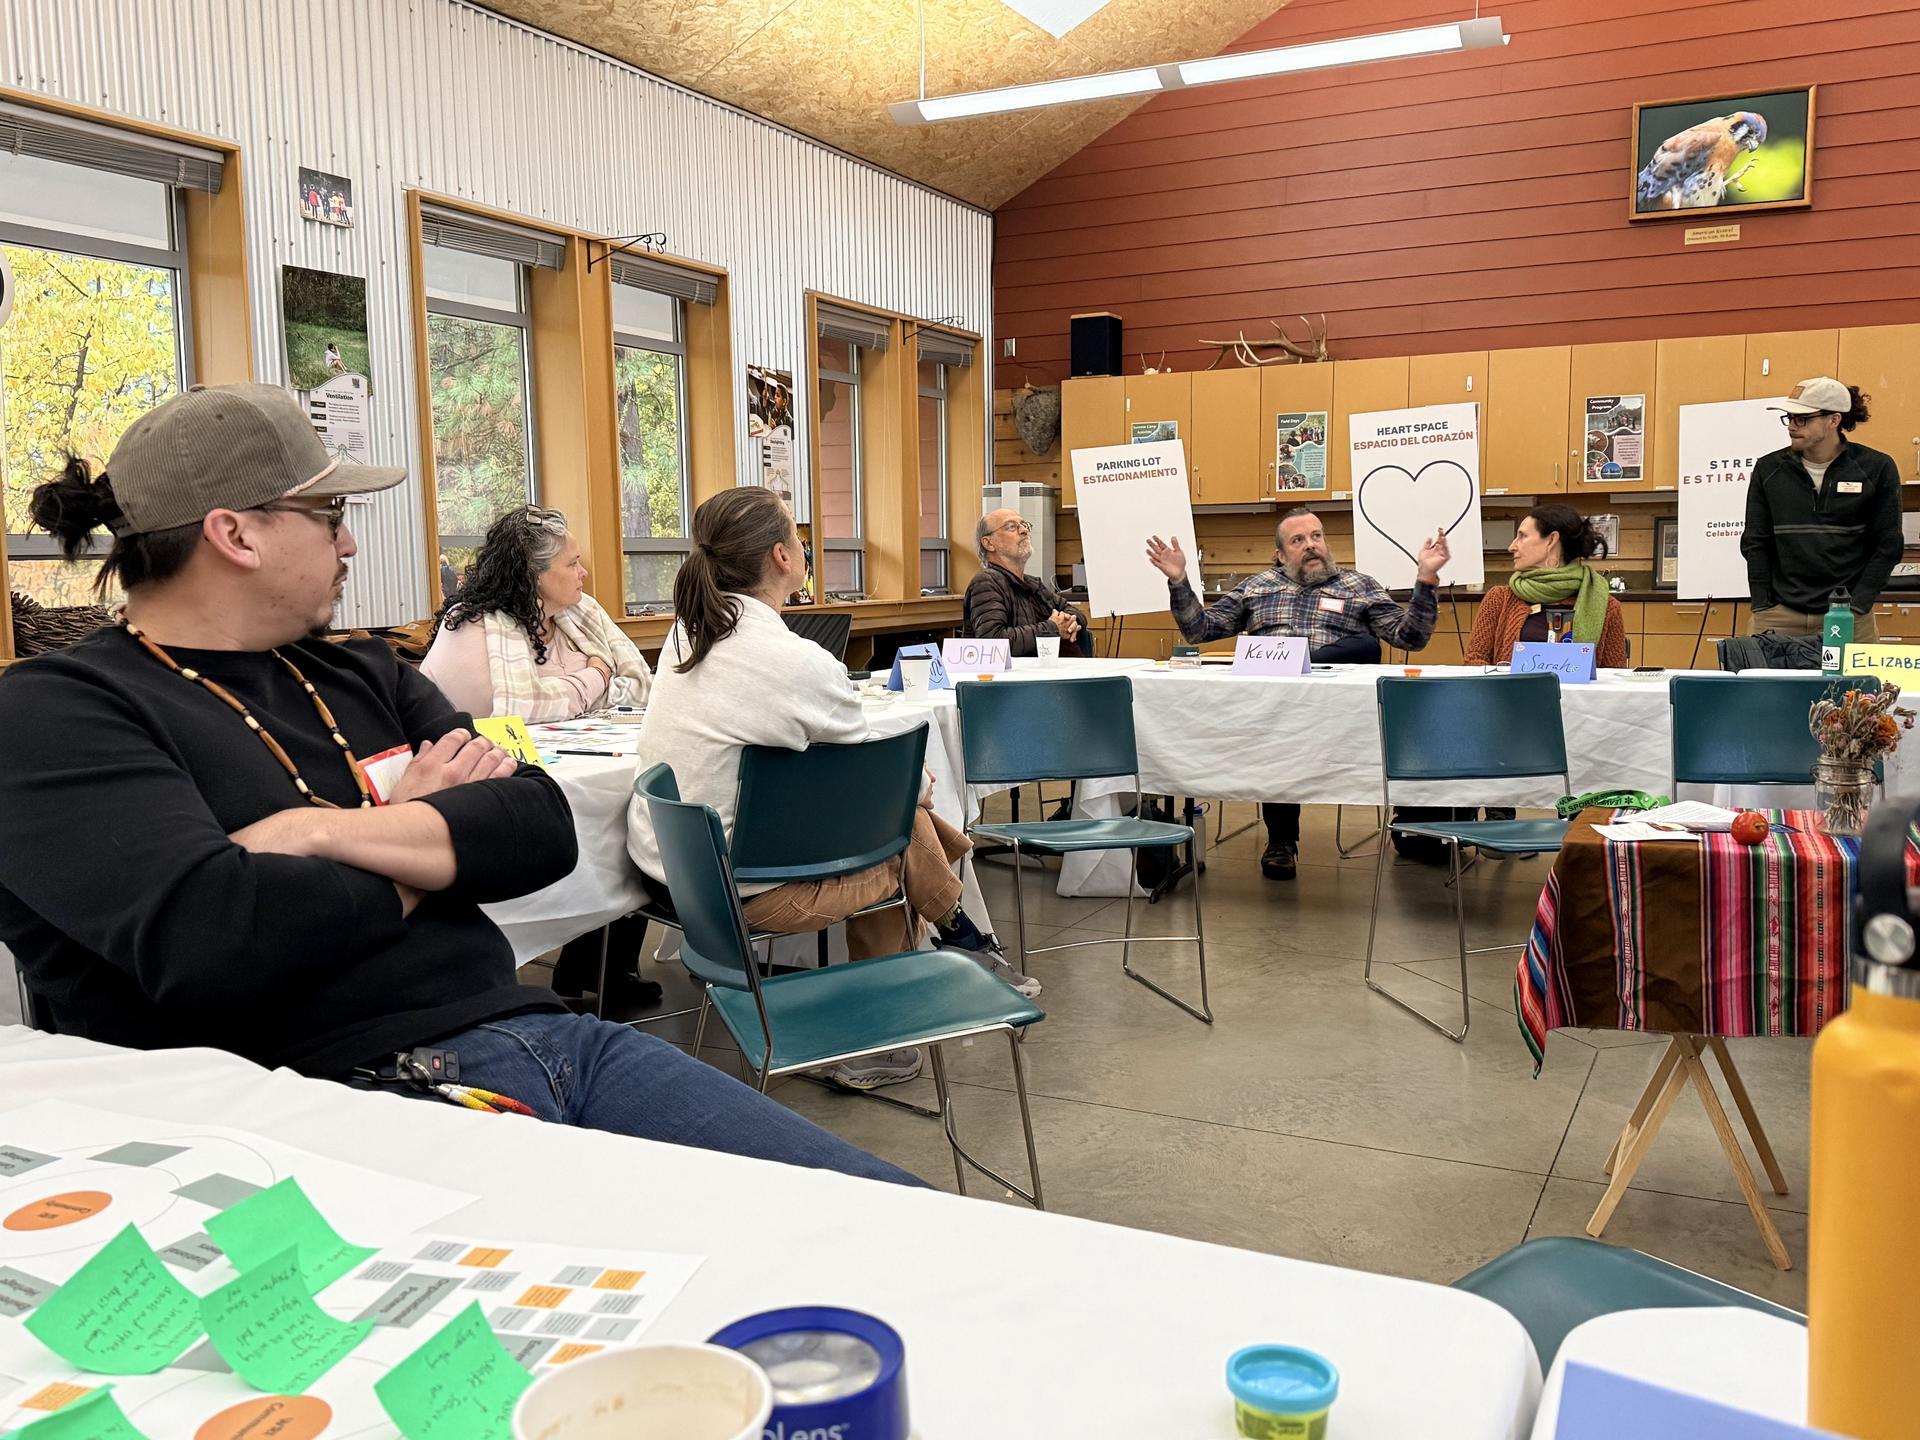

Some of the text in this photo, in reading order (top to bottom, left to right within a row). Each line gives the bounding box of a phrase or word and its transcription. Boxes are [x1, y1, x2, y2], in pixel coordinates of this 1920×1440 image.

[325, 392, 354, 400] Ventilation
[1377, 421, 1449, 436] HEART SPACE
[1353, 430, 1474, 450] ESPACIO DEL CORAZÓN
[1096, 456, 1161, 471] PARKING LOT
[1709, 458, 1753, 470] STRE
[1083, 467, 1178, 485] ESTACIONAMIENTO
[1683, 472, 1753, 485] ESTIRA
[948, 645, 1008, 665] JOHN
[1244, 643, 1290, 660] KEVIN
[1521, 653, 1571, 673] Sarah
[1852, 652, 1920, 669] ELIZABE
